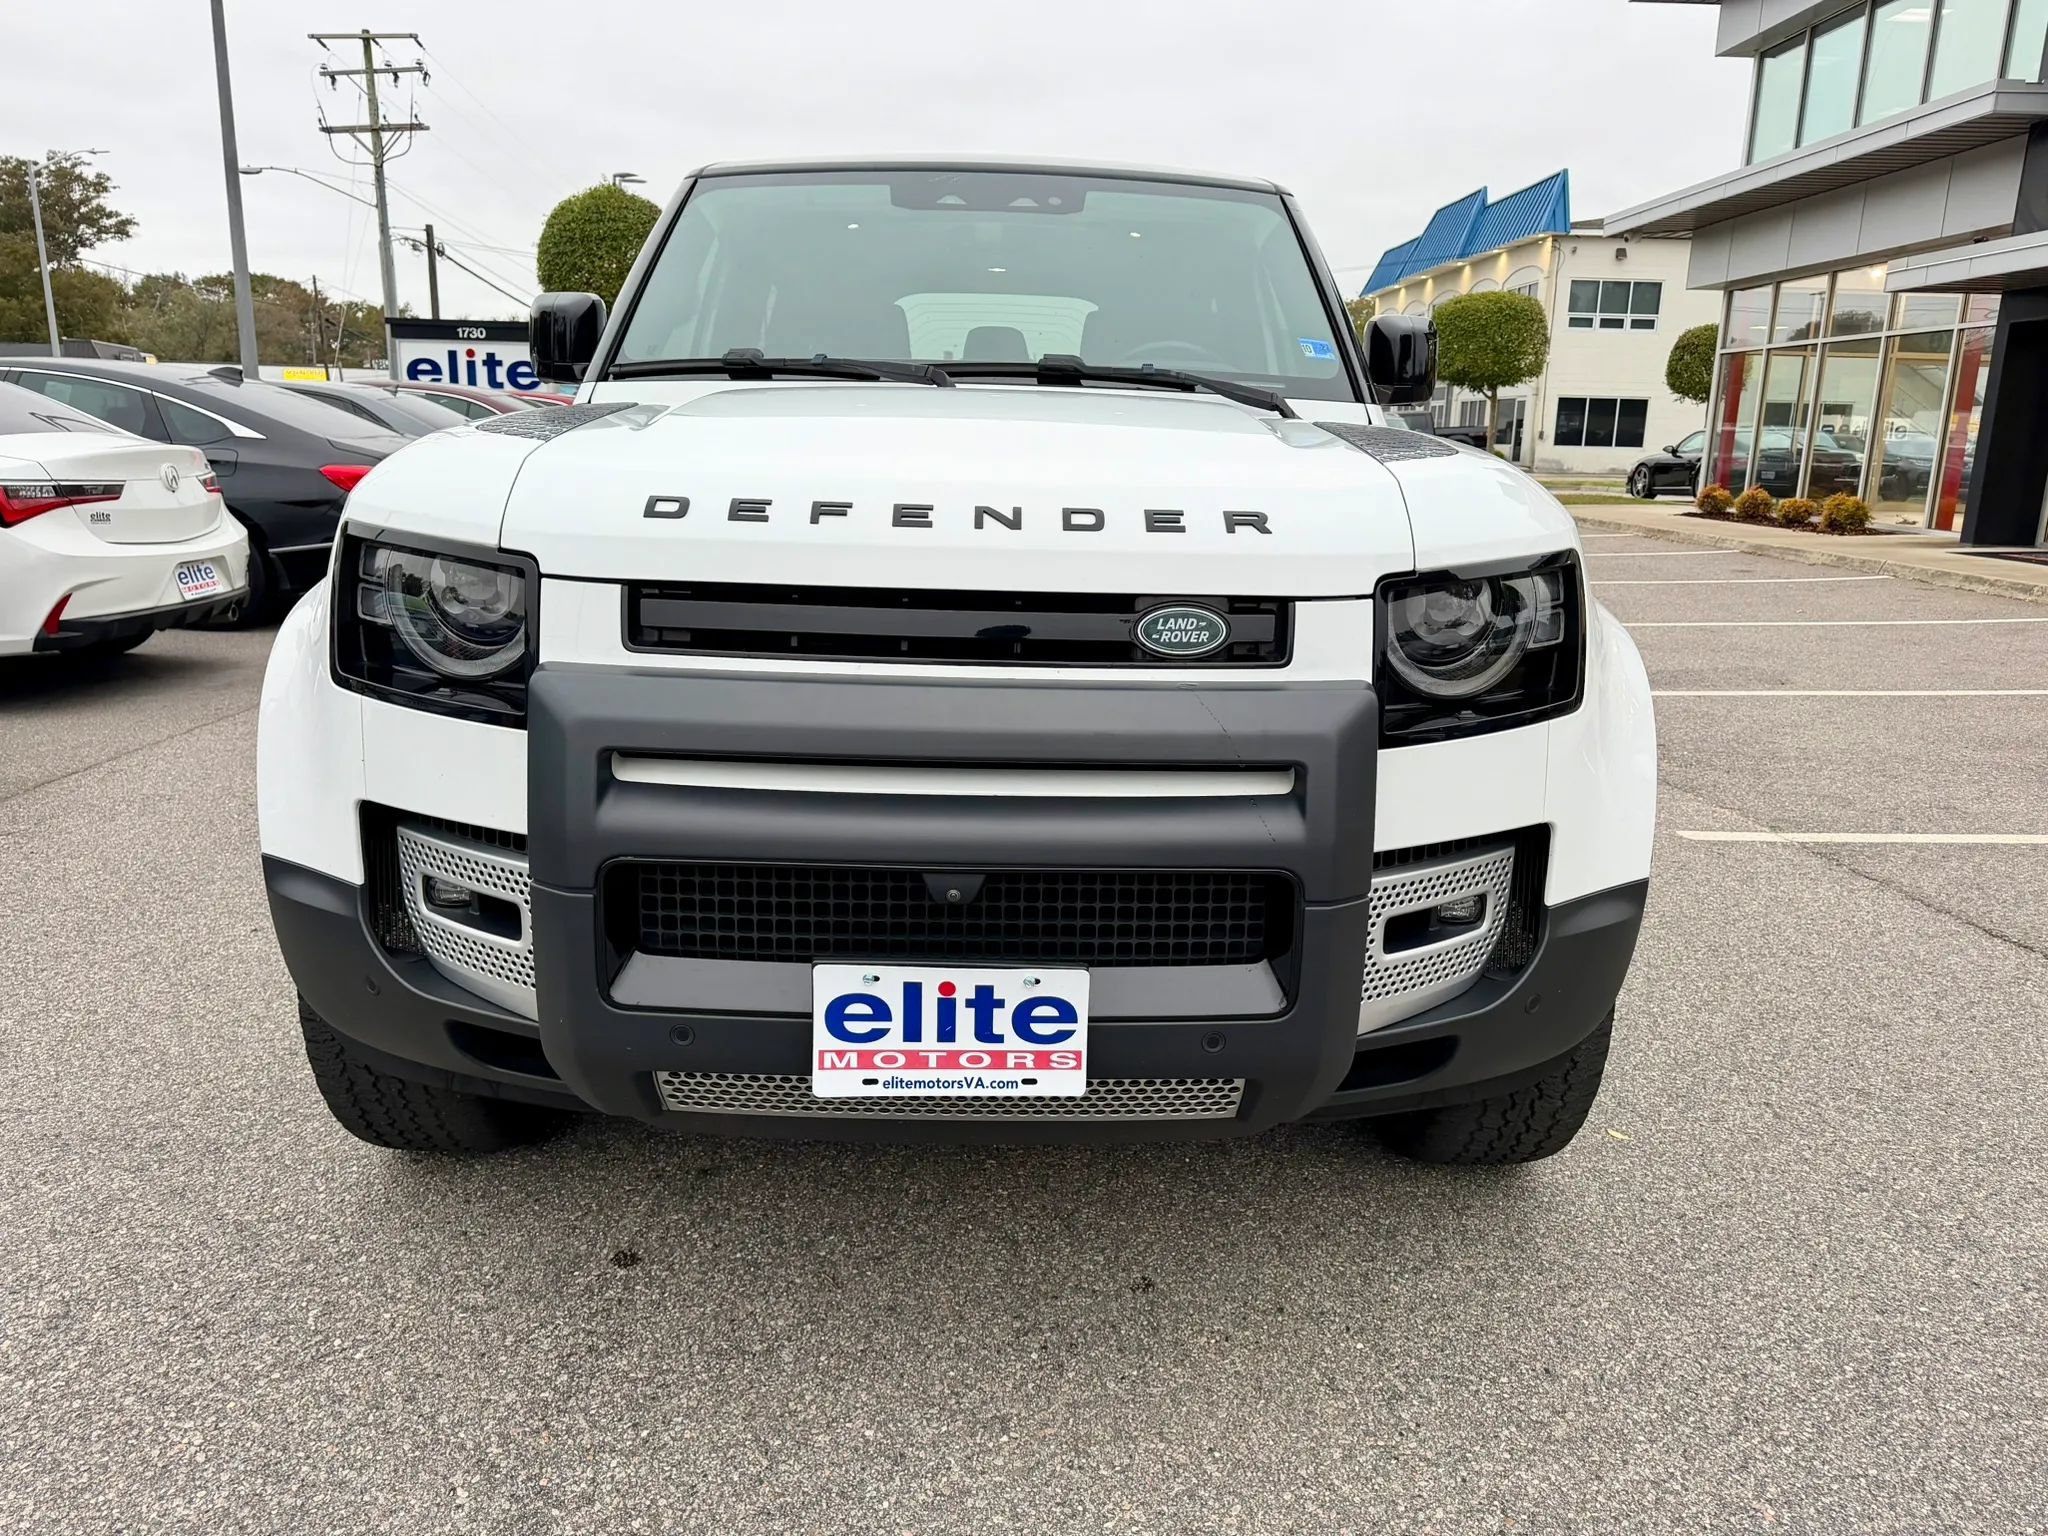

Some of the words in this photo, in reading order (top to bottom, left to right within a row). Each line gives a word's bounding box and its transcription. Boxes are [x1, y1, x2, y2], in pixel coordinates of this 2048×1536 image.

[456, 326, 486, 339] 1730
[406, 348, 541, 390] elite
[90, 511, 111, 520] elite
[643, 494, 1272, 535] DEFENDER
[177, 564, 215, 585] elite
[824, 980, 1079, 1045] elite
[823, 1051, 1078, 1069] MOTORS
[882, 1076, 1019, 1090] elitemotorsVA.com
